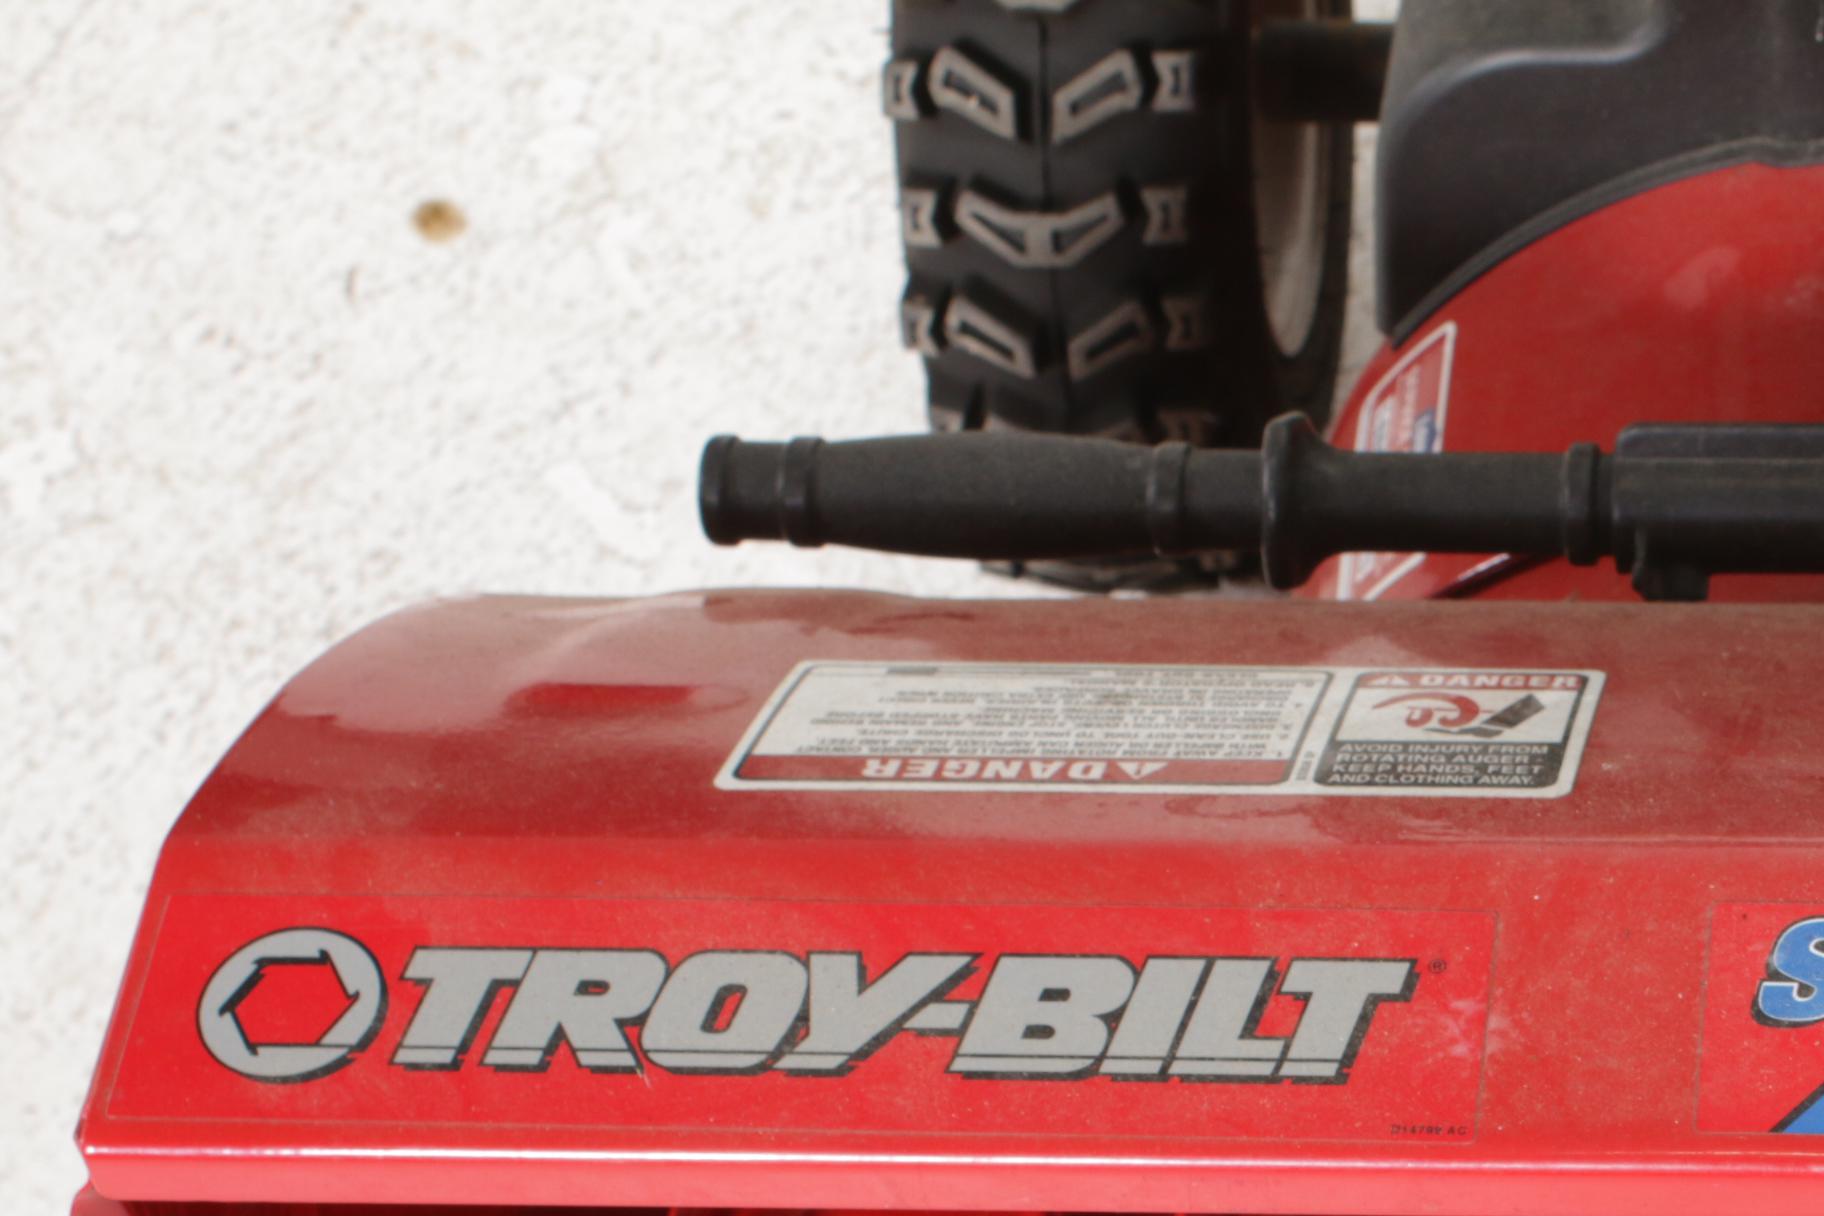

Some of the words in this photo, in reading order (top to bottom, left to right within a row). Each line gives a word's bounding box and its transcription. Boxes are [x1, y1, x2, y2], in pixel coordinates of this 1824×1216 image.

[1419, 674, 1580, 688] DANGER
[1339, 743, 1402, 754] AVOID
[1408, 744, 1481, 755] INJURY
[1488, 744, 1549, 755] FROM
[1336, 753, 1447, 763] ROTATING
[1452, 754, 1523, 764] AUGER
[861, 758, 1109, 780] DANGER
[1332, 763, 1393, 773] KEEP
[1488, 764, 1545, 775] FEET
[1328, 773, 1371, 784] AND
[1375, 774, 1473, 785] CLOTHING
[390, 946, 1420, 1085] TROY-BILT
